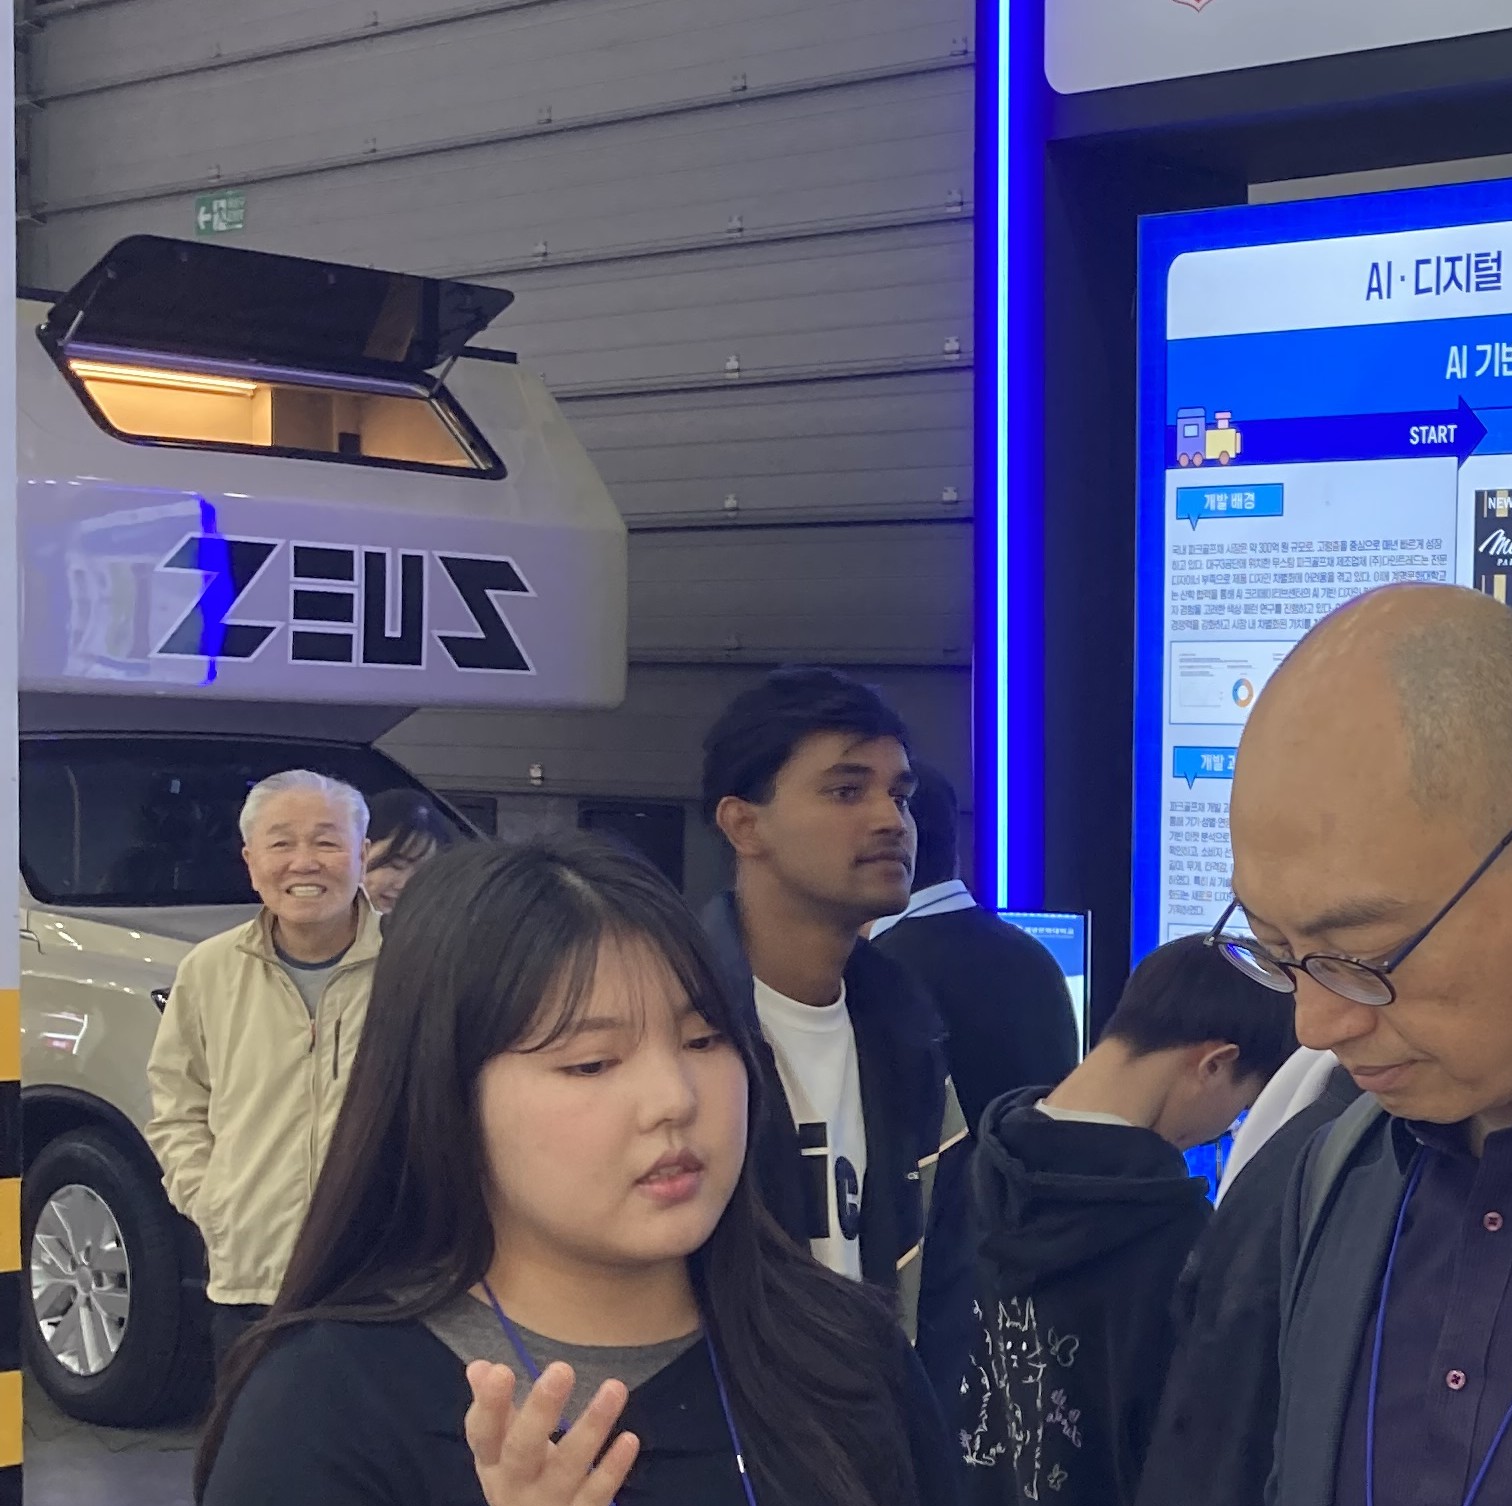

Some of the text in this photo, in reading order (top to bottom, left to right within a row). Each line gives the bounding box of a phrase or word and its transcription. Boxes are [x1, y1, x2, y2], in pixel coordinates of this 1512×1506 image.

[1446, 345, 1467, 379] AI
[1409, 424, 1458, 445] START
[1204, 492, 1256, 511] 개발 배경
[150, 531, 538, 675] ZEUS
[1201, 754, 1224, 771] 개발
